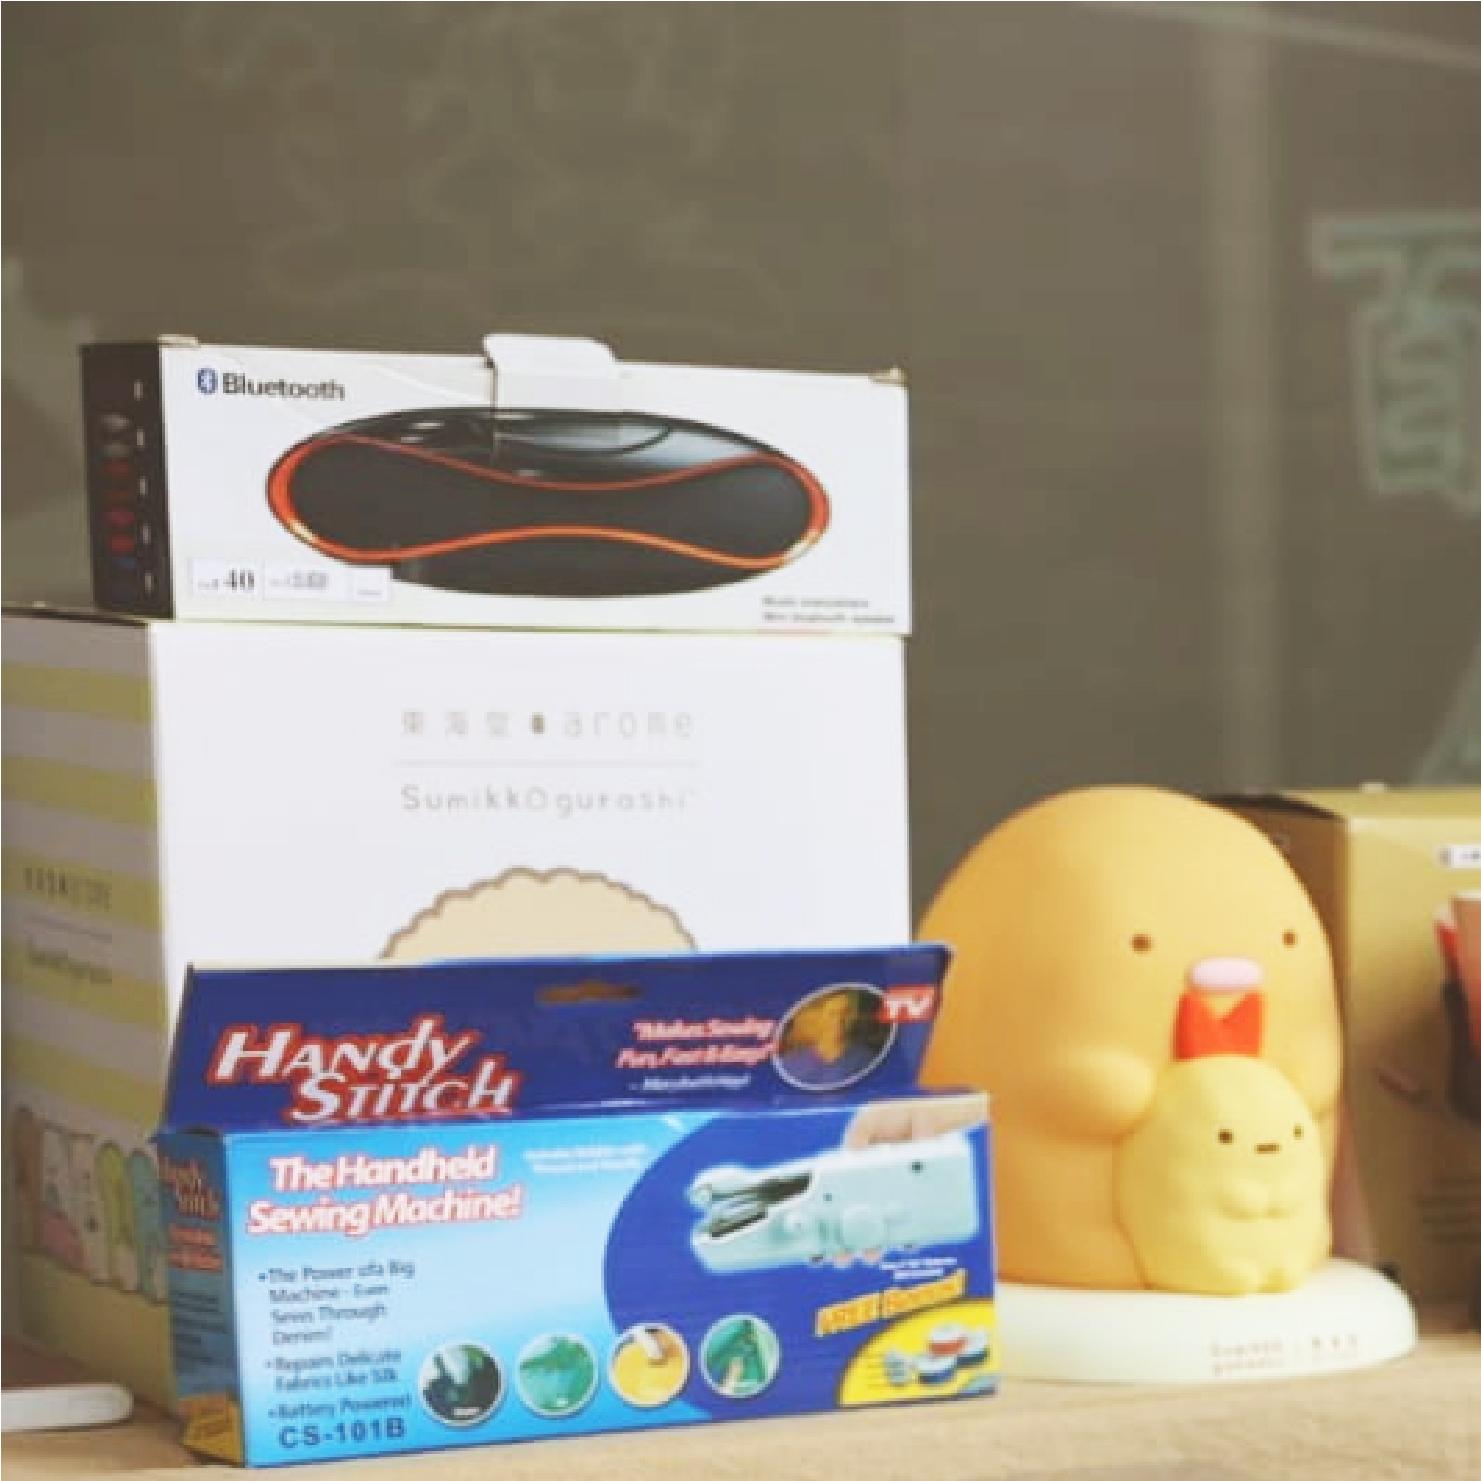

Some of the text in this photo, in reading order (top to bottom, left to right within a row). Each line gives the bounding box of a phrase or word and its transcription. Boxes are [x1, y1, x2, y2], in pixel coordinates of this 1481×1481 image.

[222, 372, 346, 401] Bluetooth
[268, 1155, 335, 1192] The
[336, 1143, 498, 1189] Handheld
[246, 1197, 370, 1238] Sewing
[371, 1182, 524, 1227] Machine!
[279, 1417, 406, 1449] CS-101B
